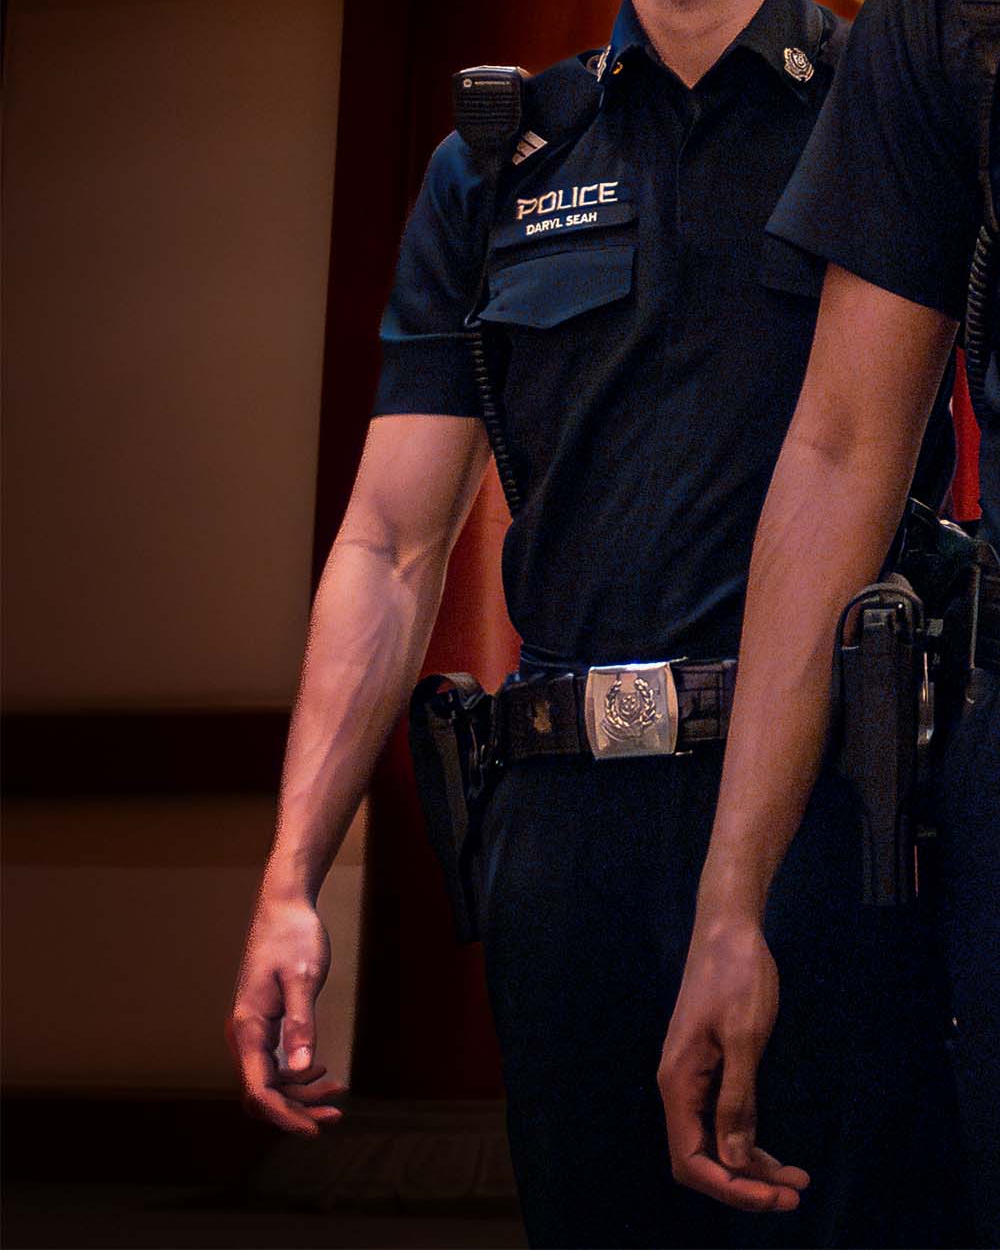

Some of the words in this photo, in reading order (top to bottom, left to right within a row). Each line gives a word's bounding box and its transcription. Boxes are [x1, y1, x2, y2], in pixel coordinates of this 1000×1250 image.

[516, 181, 619, 220] POLICE
[525, 217, 563, 236] DARYL
[566, 211, 598, 227] SEAH
